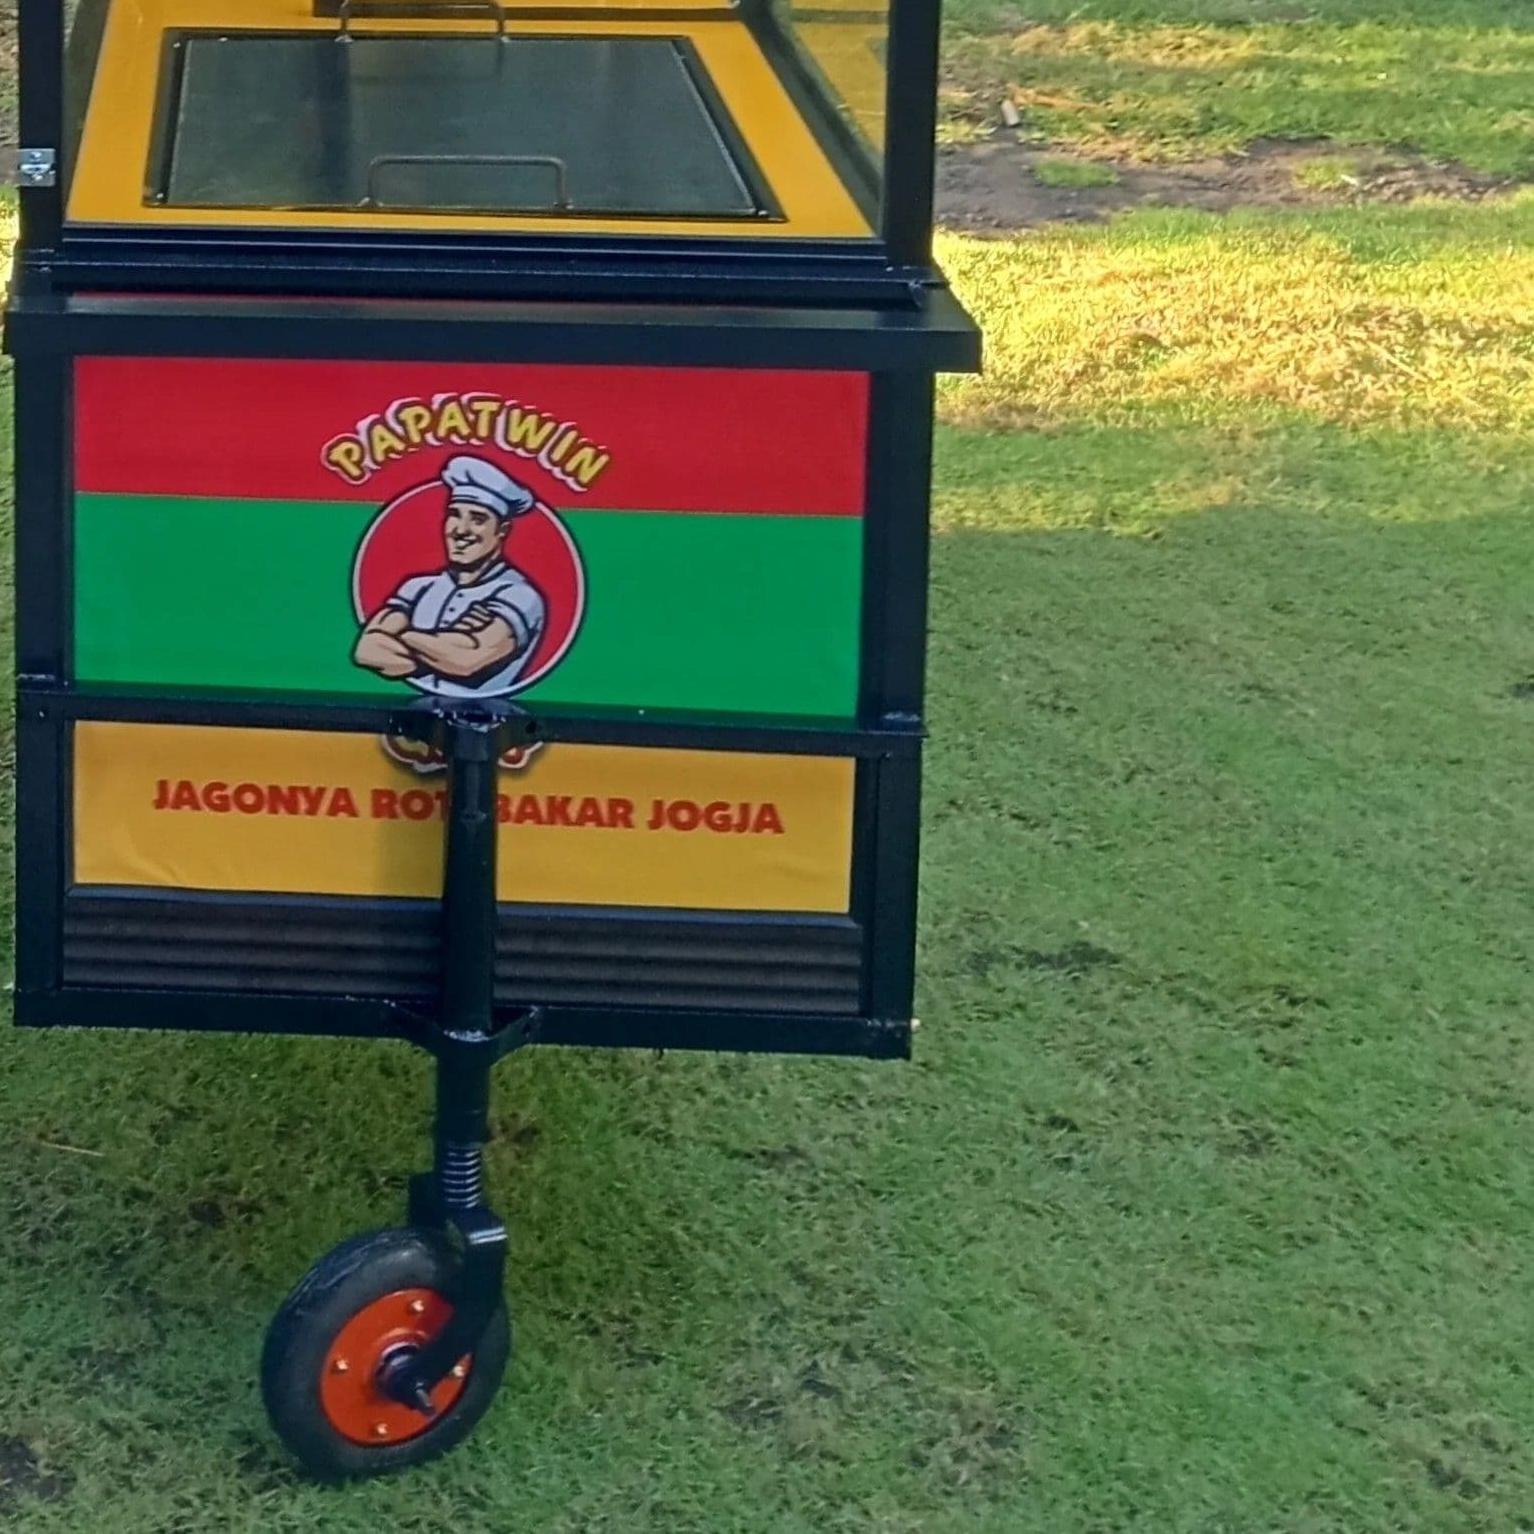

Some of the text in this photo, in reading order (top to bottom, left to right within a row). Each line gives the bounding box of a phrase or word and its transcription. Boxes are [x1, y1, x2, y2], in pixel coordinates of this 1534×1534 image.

[324, 396, 611, 487] PAPATWIN
[152, 778, 358, 818] JAGONYA
[370, 788, 450, 821] ROT
[647, 799, 785, 835] JOGJA
